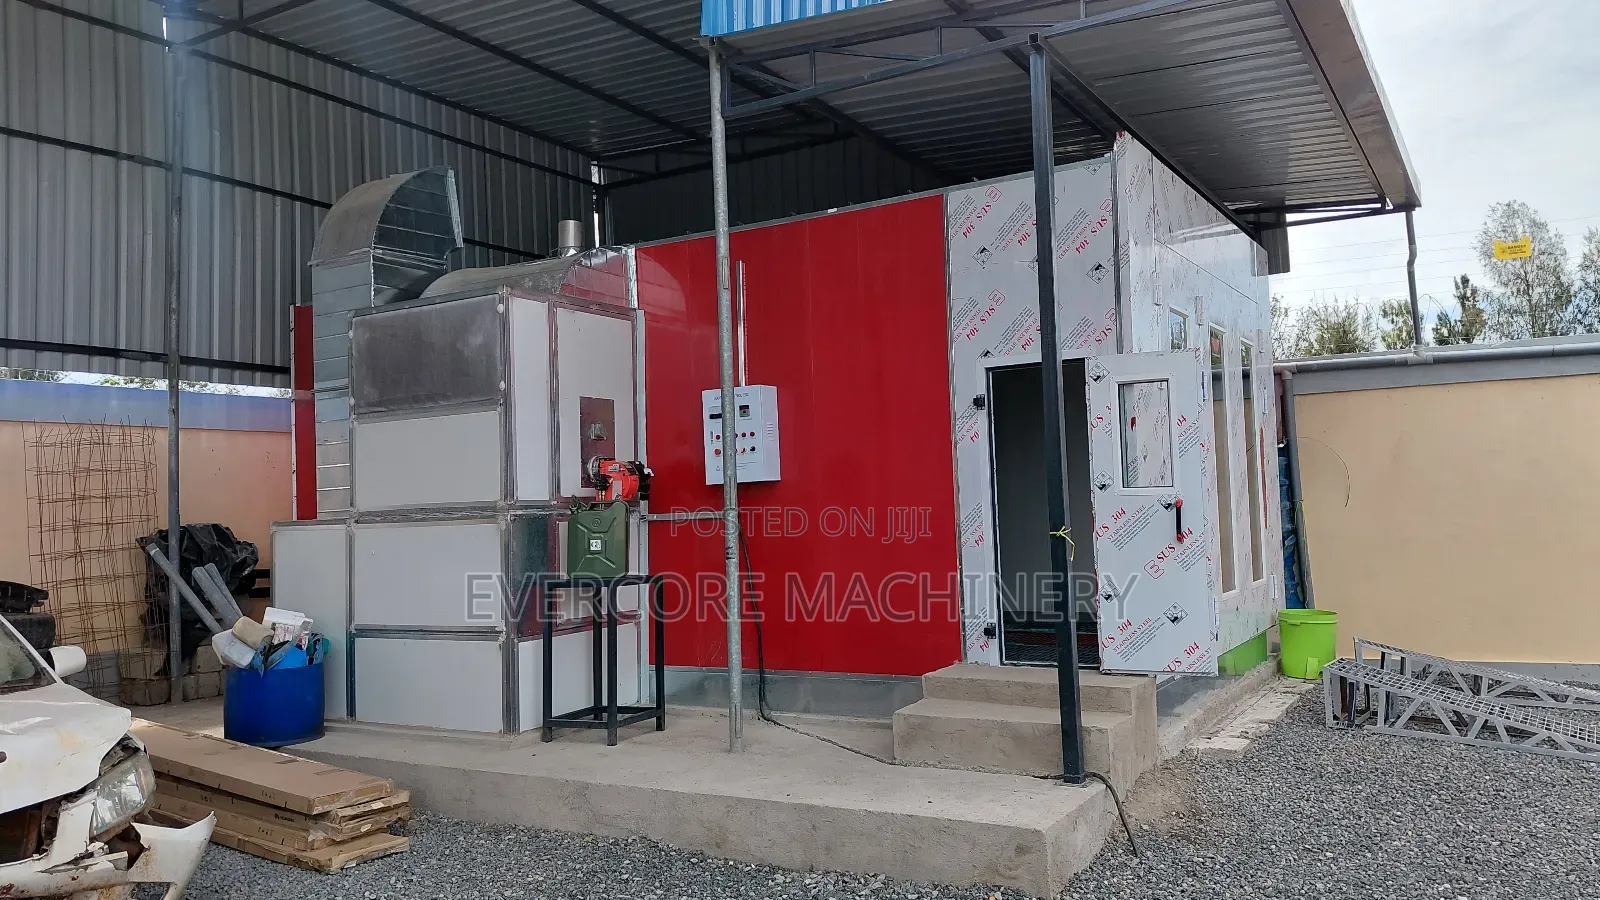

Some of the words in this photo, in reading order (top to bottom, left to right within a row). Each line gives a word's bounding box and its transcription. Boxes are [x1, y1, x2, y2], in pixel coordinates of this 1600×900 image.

[975, 201, 992, 221] SUS
[962, 221, 976, 239] 304
[1090, 215, 1108, 236] SUS
[1017, 228, 1031, 246] 304
[1075, 236, 1090, 254] 304
[979, 304, 996, 324] SUS
[965, 324, 979, 341] 304
[1094, 324, 1113, 345] SUS
[1020, 334, 1035, 352] 304
[1090, 414, 1104, 431] US
[1106, 518, 1132, 541] STAINLESS
[1130, 504, 1146, 519] STEEL
[1110, 506, 1127, 524] 304
[1156, 543, 1176, 563] SUS
[1173, 538, 1199, 561] STAINLESS
[1112, 630, 1138, 652] STAINLESS
[1136, 617, 1152, 631] STEEL
[1116, 618, 1133, 635] 304
[1183, 641, 1200, 658] 304
